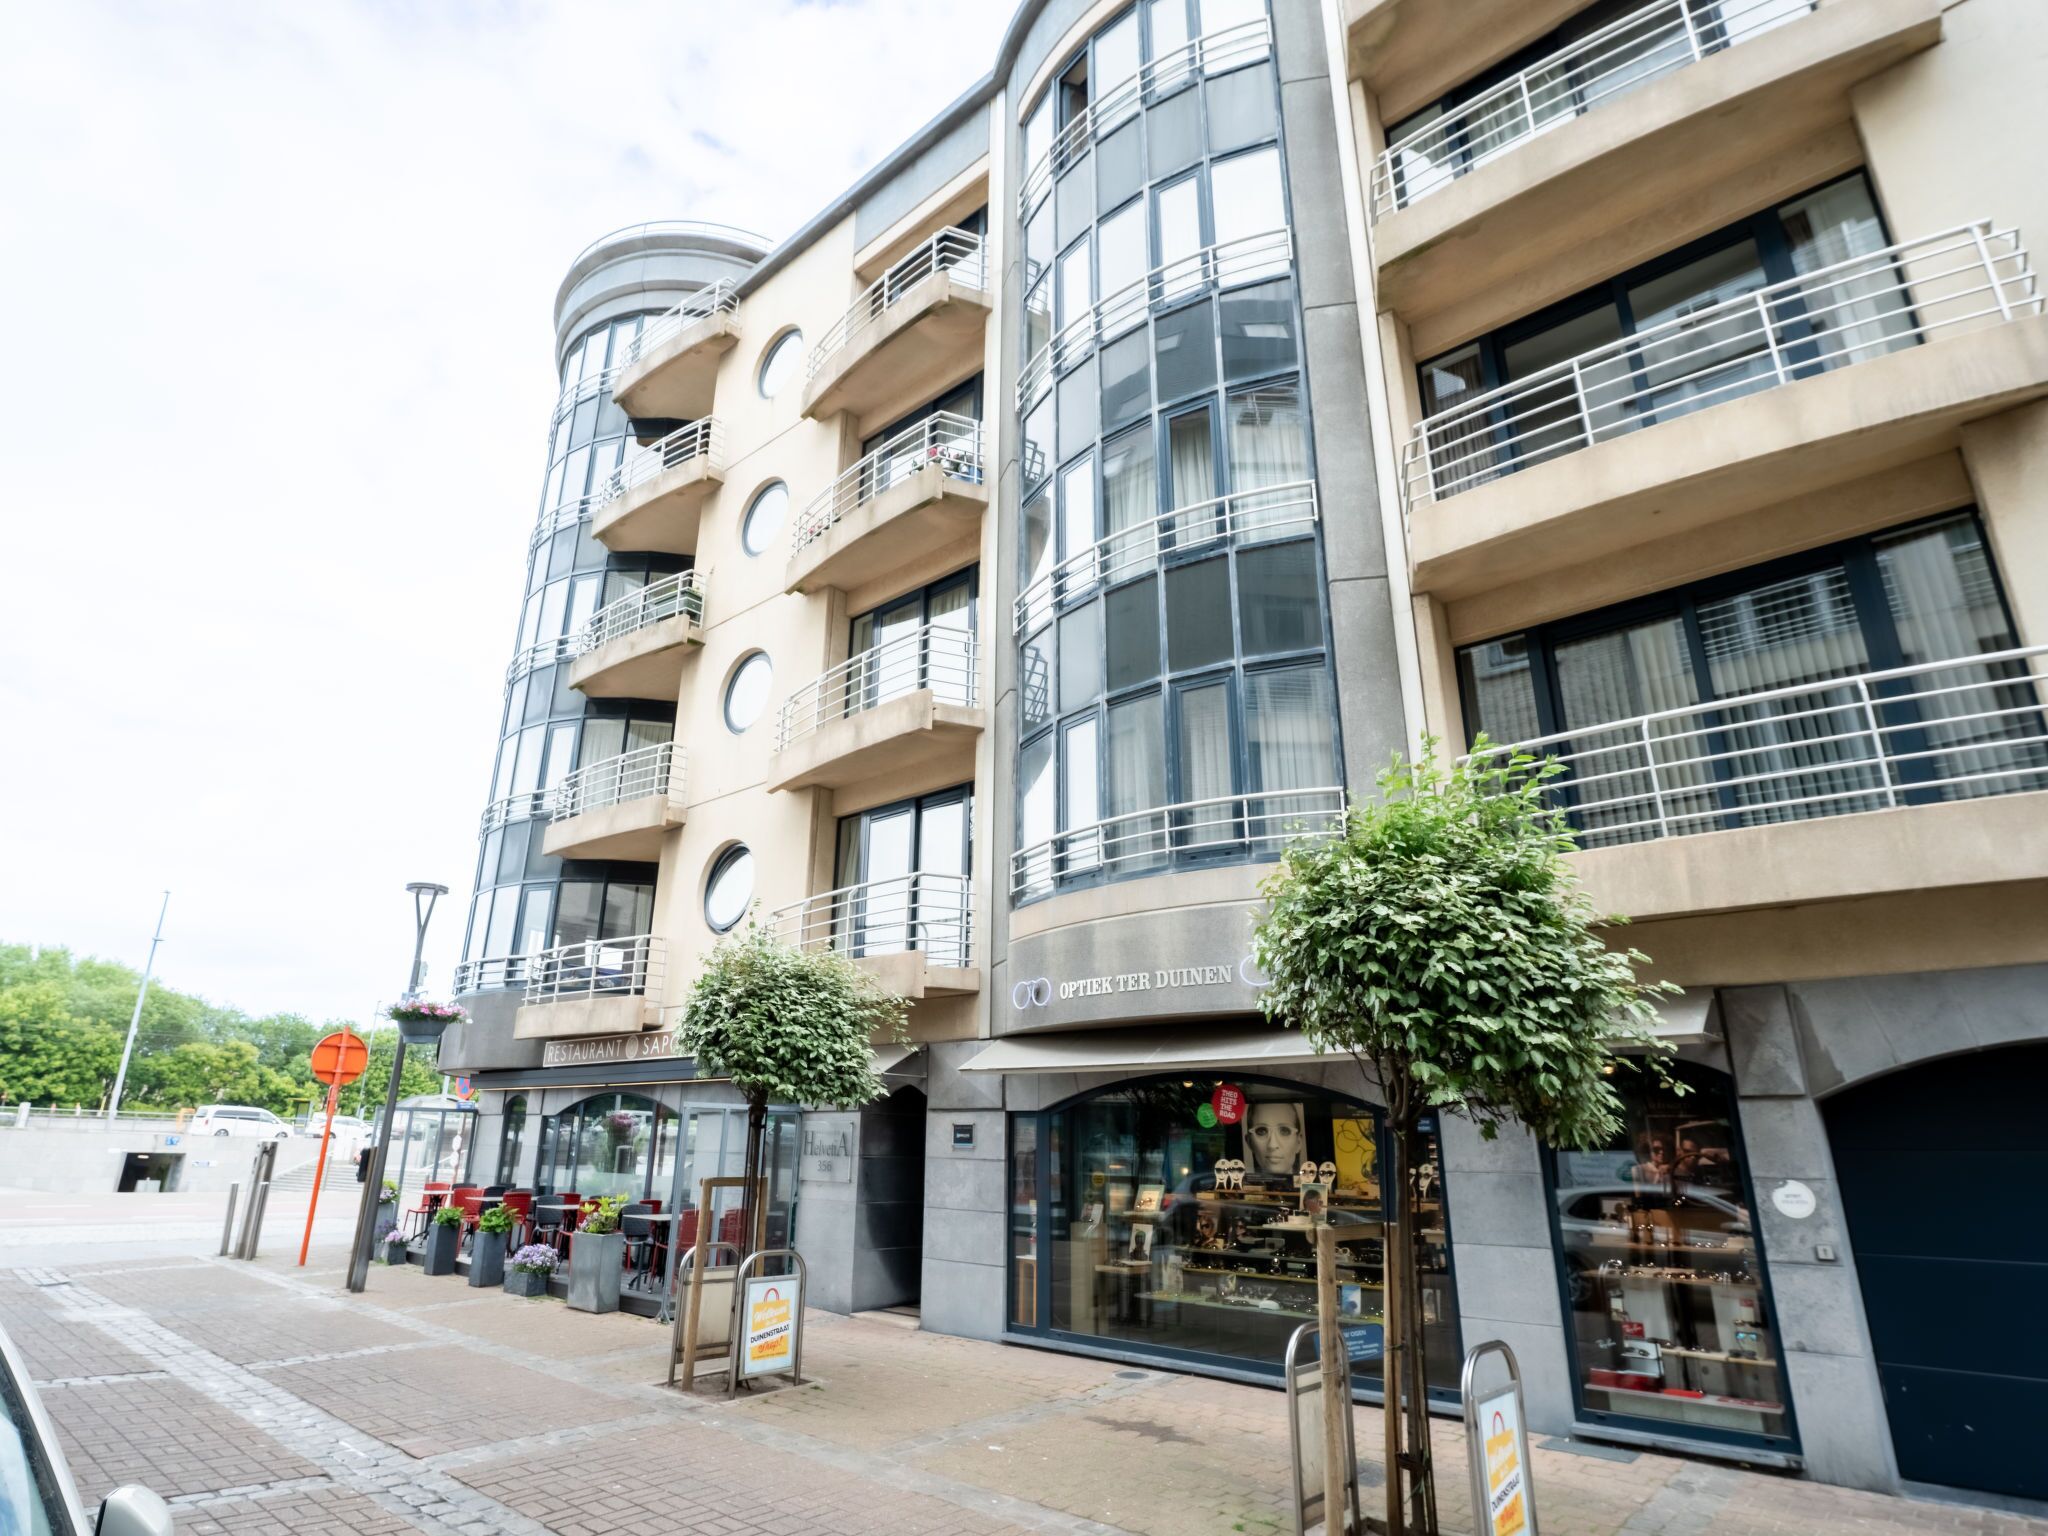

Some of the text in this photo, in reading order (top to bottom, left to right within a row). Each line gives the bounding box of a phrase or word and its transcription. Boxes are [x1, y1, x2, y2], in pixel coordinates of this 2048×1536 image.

[1059, 965, 1233, 1001] OPTIEK TER DUINEN
[548, 1039, 623, 1062] RESTAURANT
[1222, 1089, 1238, 1098] THEO
[1221, 1097, 1237, 1105] HITS
[1220, 1103, 1233, 1112] THE
[1219, 1110, 1236, 1120] ROAD
[817, 1160, 832, 1172] 356
[750, 1323, 790, 1344] DUINENSTRAAT
